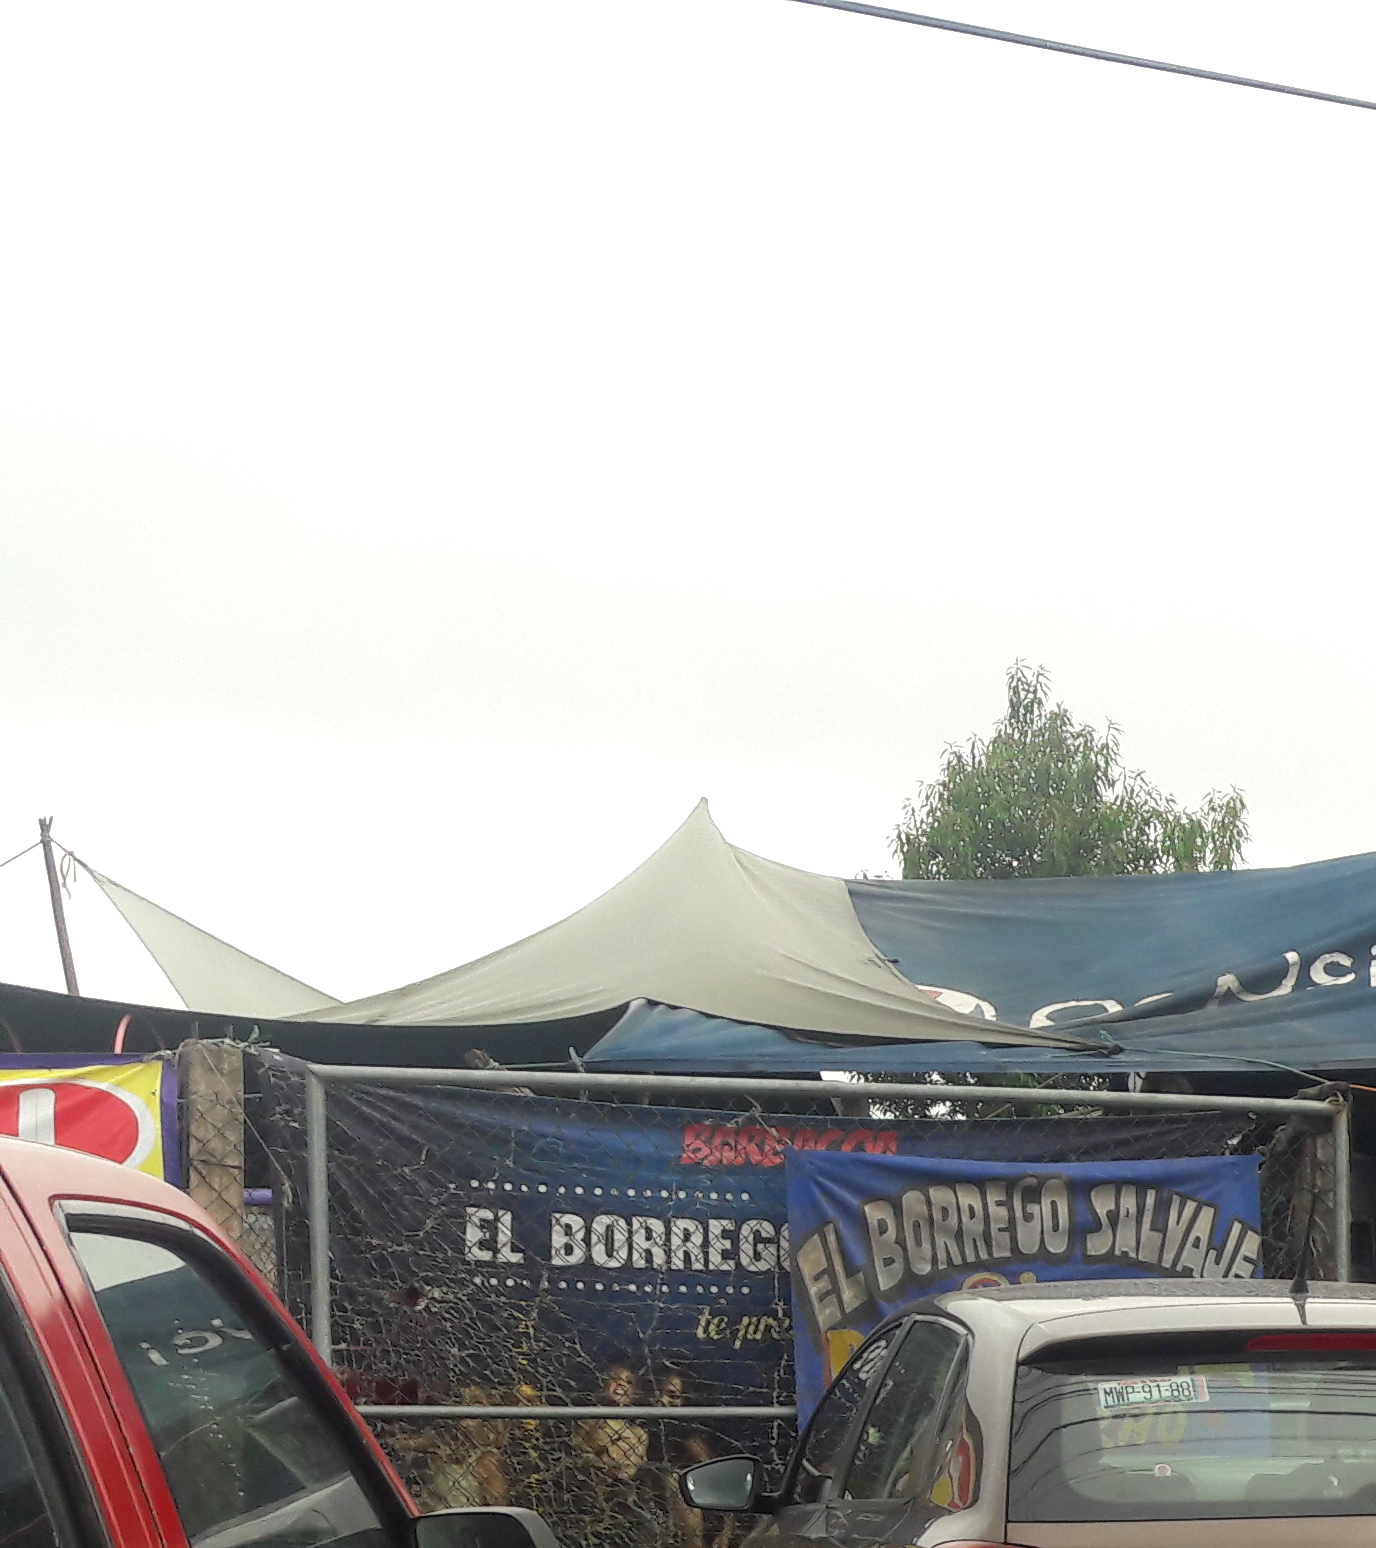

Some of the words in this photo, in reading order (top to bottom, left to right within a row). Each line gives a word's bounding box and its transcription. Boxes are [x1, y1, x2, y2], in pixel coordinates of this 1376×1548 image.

[464, 1206, 525, 1264] EL
[550, 1212, 791, 1273] BORREG
[797, 1223, 867, 1333] EL
[863, 1174, 1070, 1292] BORREGO
[1085, 1183, 1262, 1279] SALVAJE
[1103, 1380, 1193, 1407] MWP-91-88
